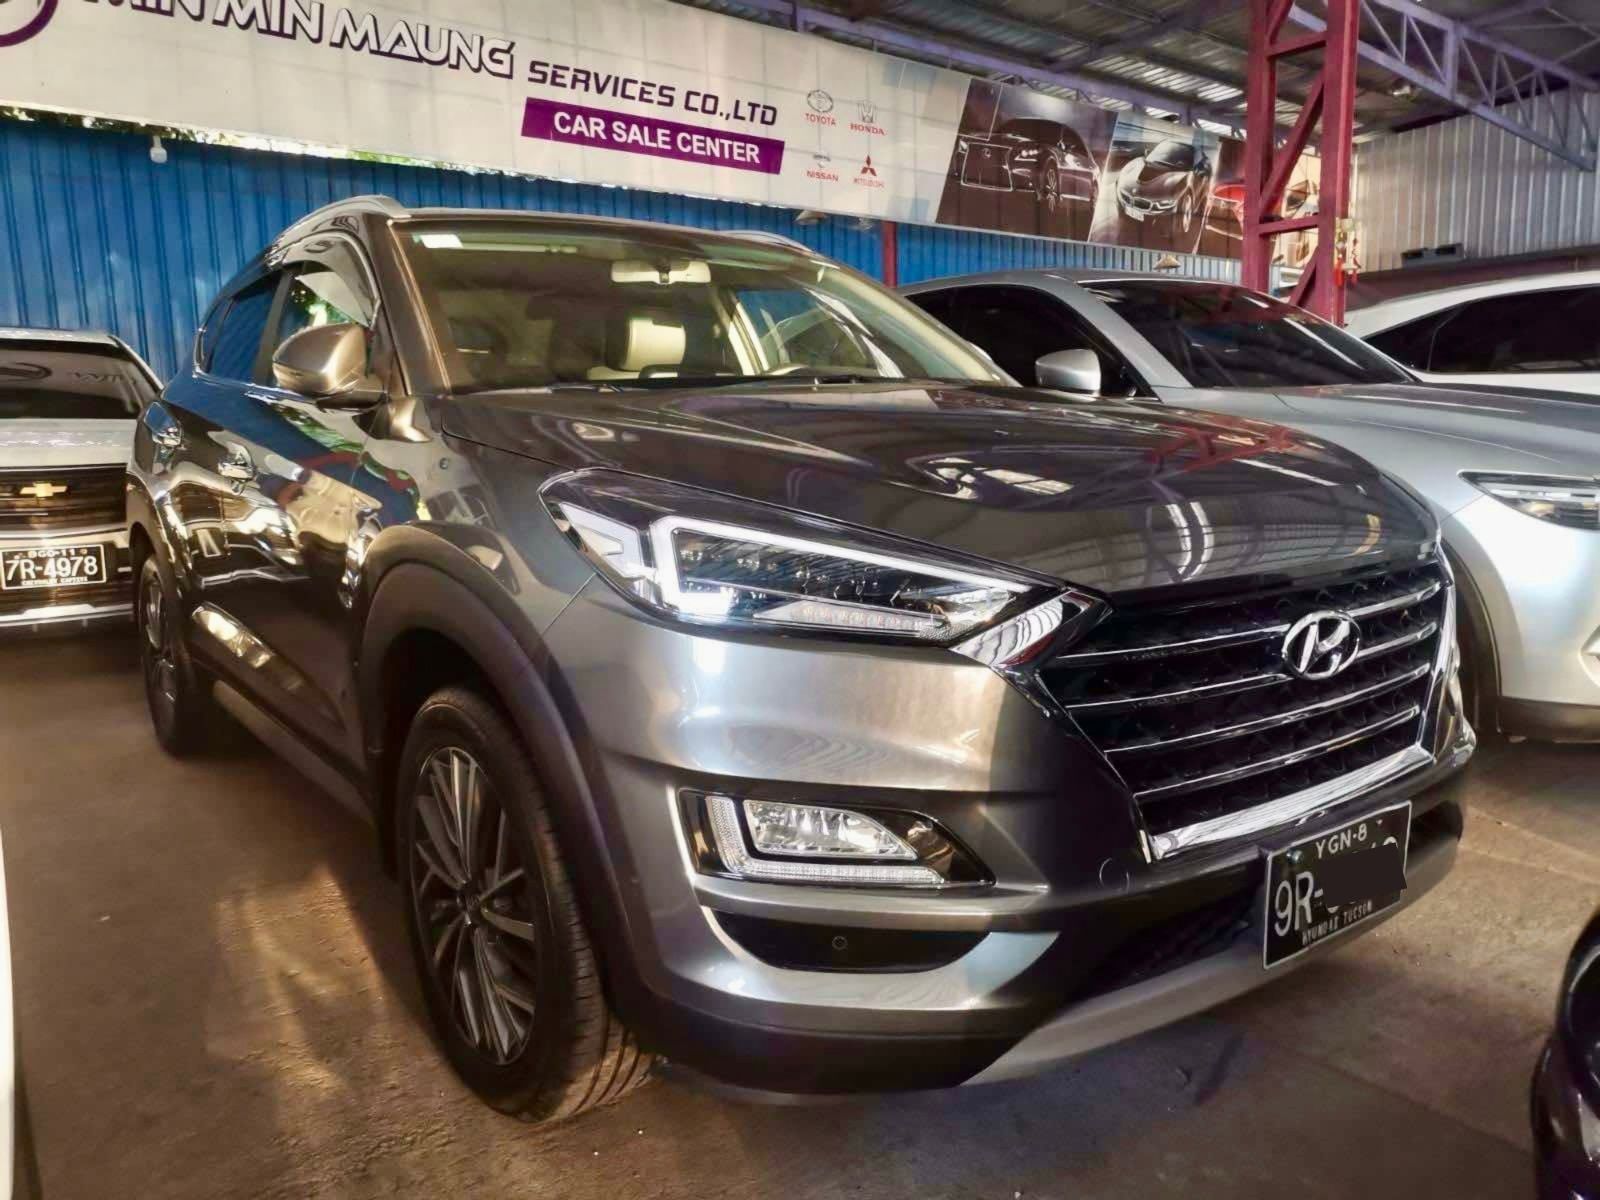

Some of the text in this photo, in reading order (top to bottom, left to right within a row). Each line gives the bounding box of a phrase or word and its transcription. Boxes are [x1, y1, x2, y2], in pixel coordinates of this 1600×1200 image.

[212, 0, 322, 43] MIN
[329, 8, 515, 79] MAUNG
[528, 60, 676, 107] SERVICES
[683, 90, 778, 126] CO.,LTD
[805, 113, 836, 126] TOYOTA
[850, 122, 885, 135] HONDA
[554, 111, 761, 164] CAR SALE CENTER
[806, 170, 839, 181] NISSAN
[5, 556, 98, 581] 7R-4978
